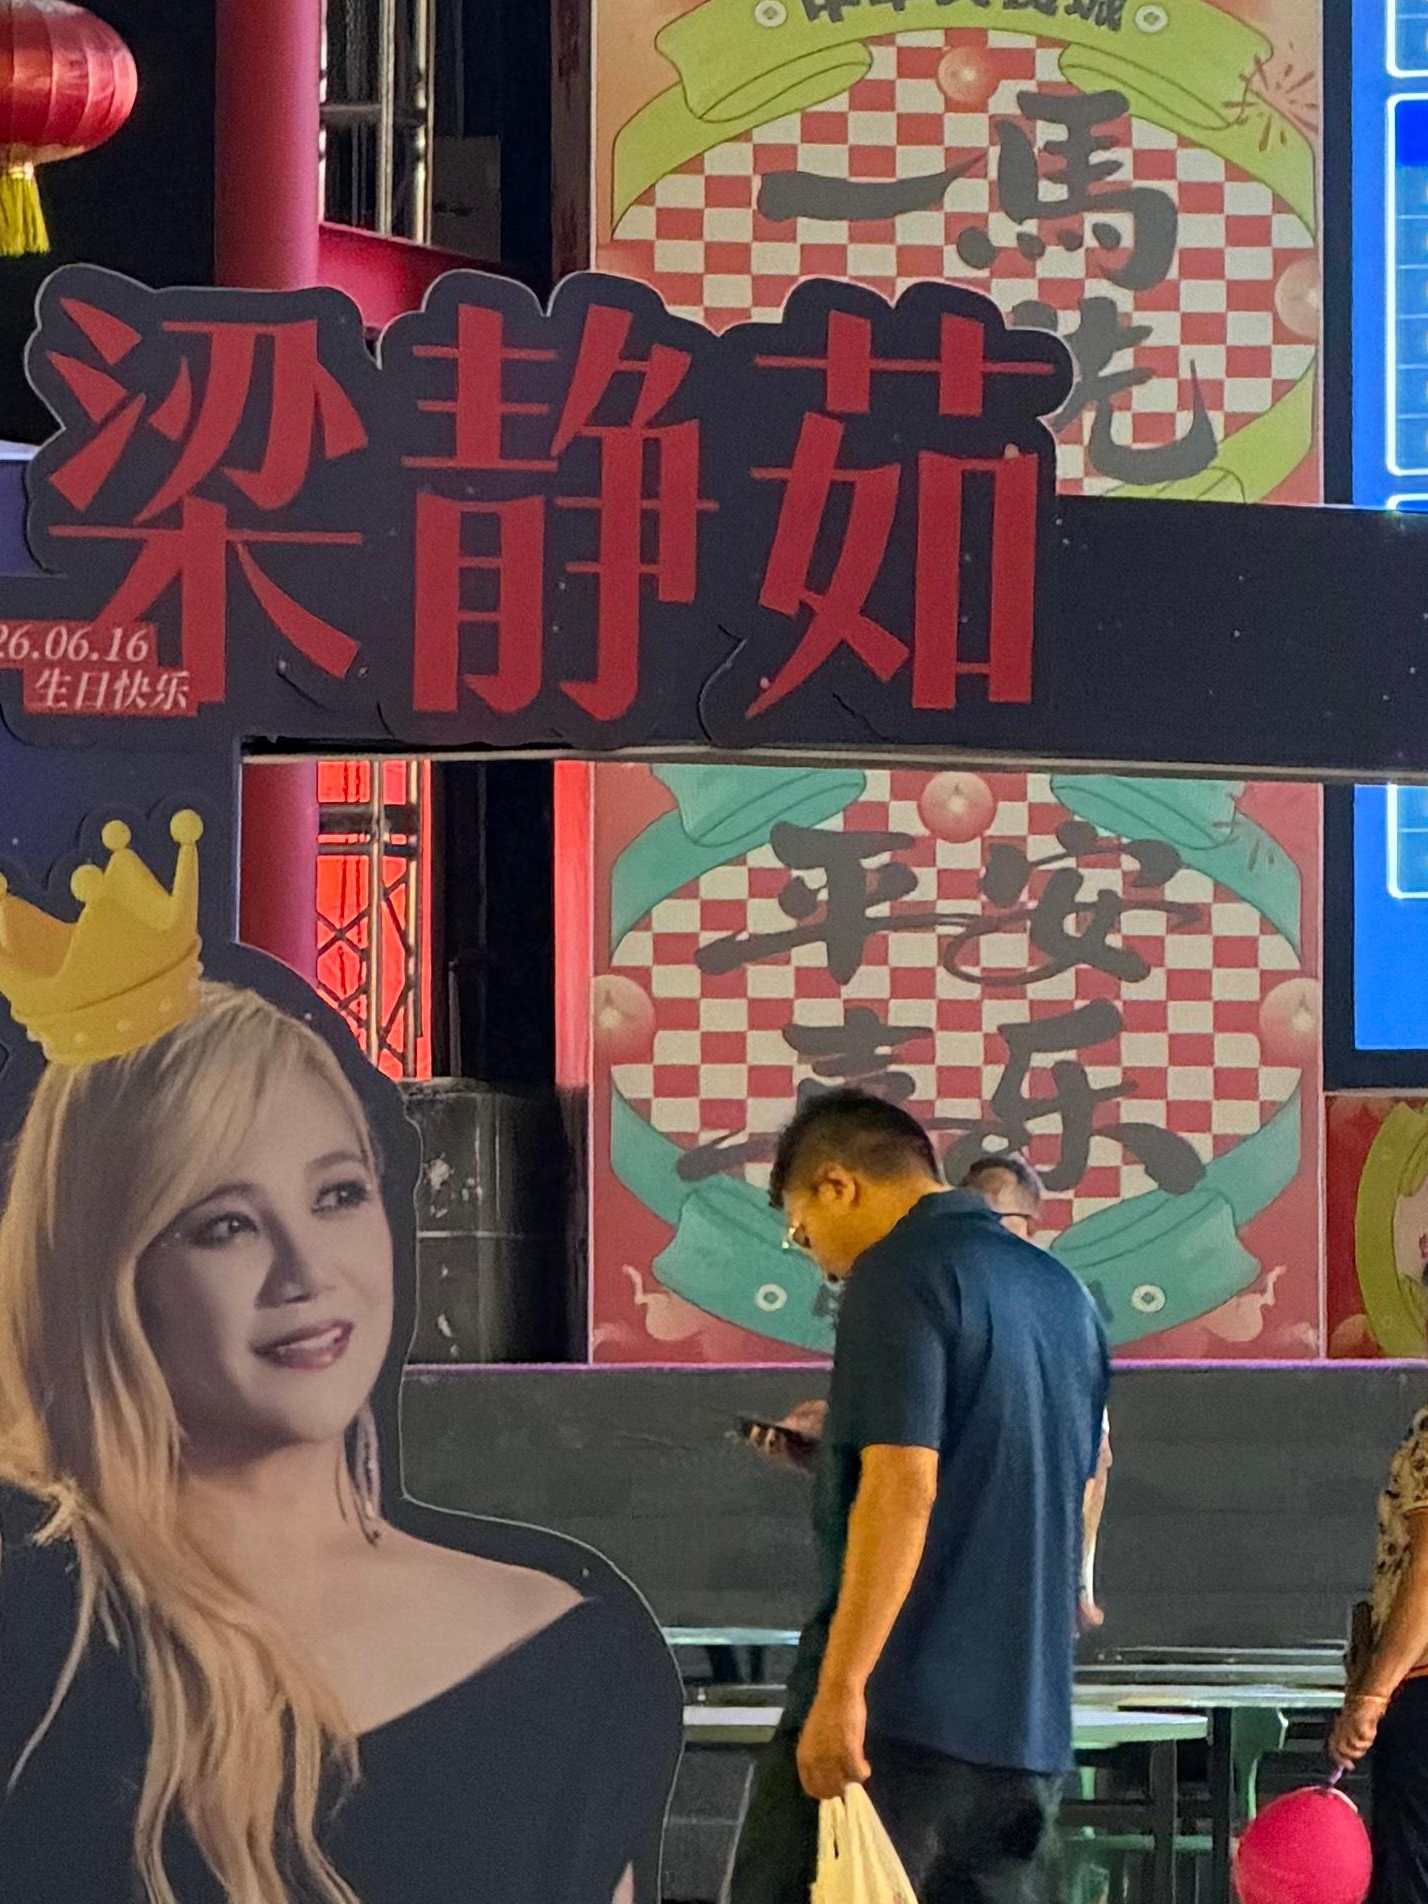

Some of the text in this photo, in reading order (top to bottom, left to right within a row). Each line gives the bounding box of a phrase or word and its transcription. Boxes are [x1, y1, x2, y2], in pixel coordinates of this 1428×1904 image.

[48, 296, 1056, 721] 梁静茹
[34, 667, 191, 712] 生日快乐
